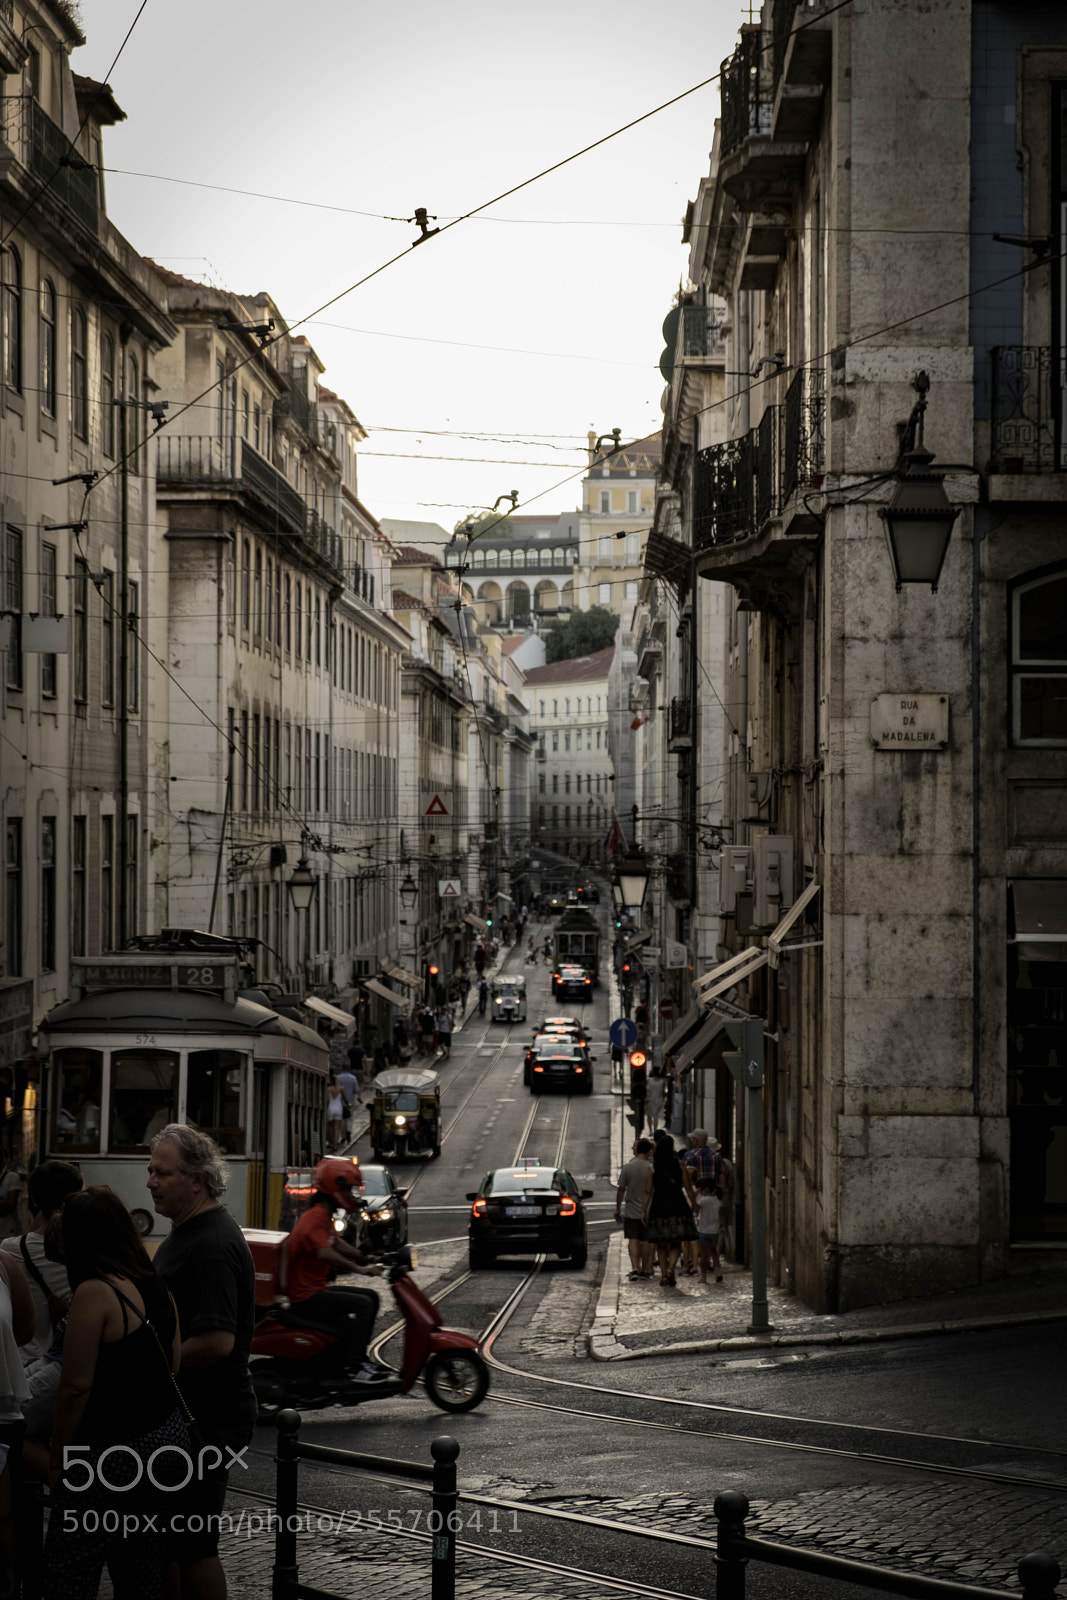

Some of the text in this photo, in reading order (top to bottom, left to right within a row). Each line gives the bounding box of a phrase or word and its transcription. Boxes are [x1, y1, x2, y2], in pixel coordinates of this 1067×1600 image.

[901, 701, 918, 710] RUA
[903, 717, 915, 725] DA
[882, 732, 936, 741] MADALENA
[187, 967, 214, 985] 28
[136, 1035, 155, 1045] 574
